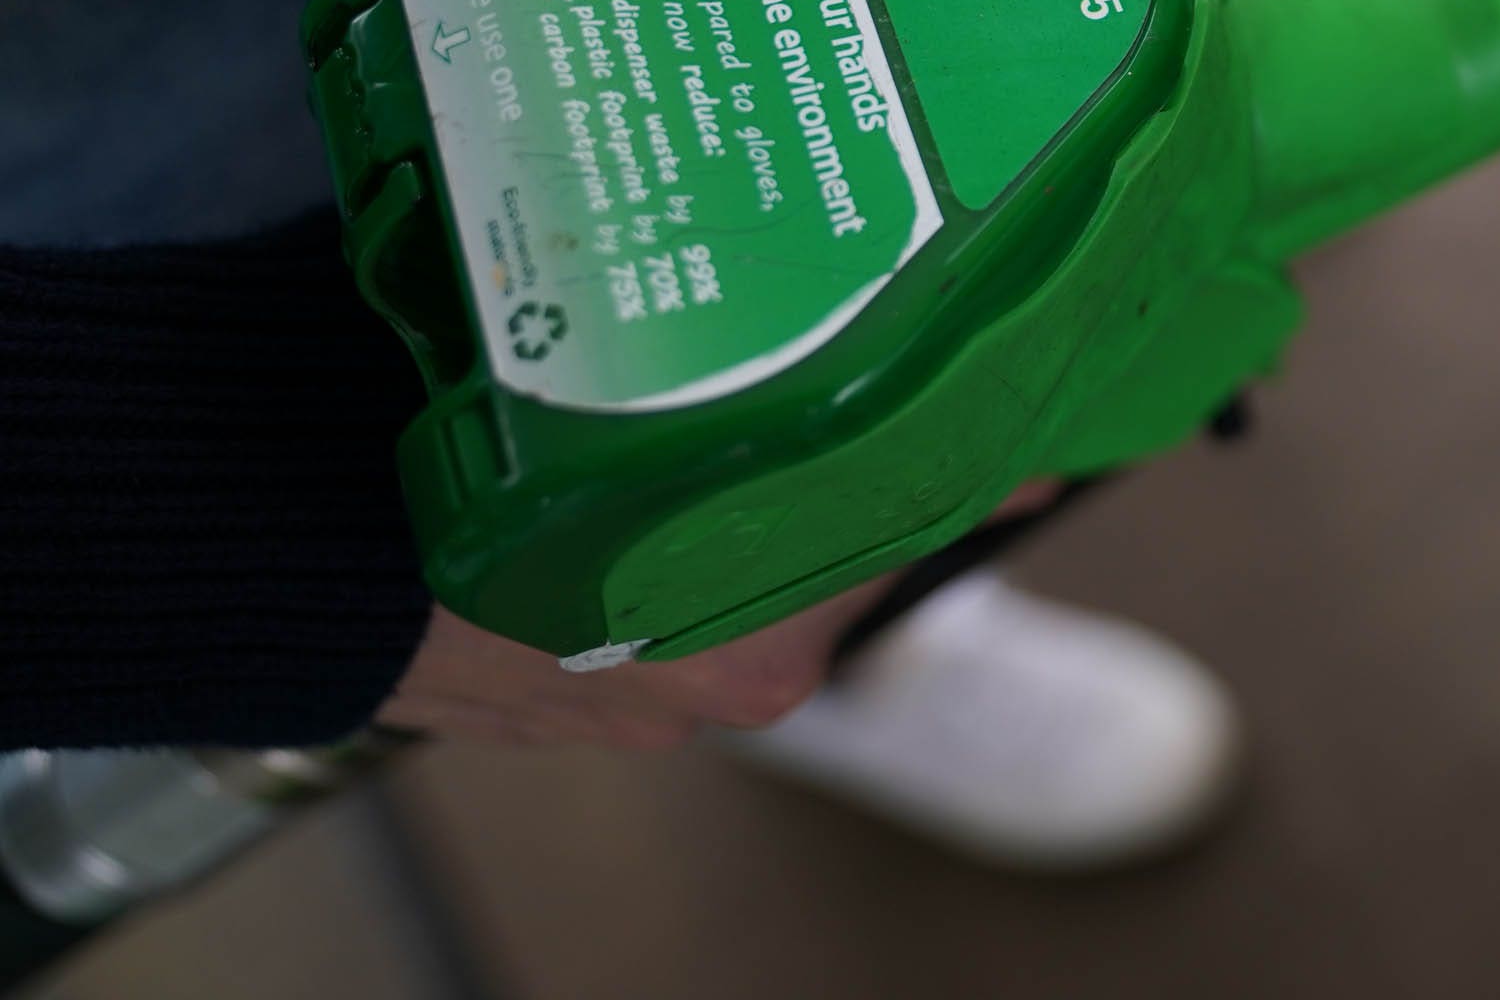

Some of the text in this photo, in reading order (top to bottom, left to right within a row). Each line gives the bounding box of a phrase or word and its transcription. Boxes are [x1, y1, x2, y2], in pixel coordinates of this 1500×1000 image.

[475, 14, 507, 62] use
[490, 66, 523, 123] one
[662, 1, 695, 52] now
[679, 64, 726, 157] reduce:
[729, 82, 755, 113] to
[831, 34, 890, 132] hands
[538, 12, 647, 322] carbon footprint by 75%
[568, 5, 685, 313] plastic footprint by 70%
[734, 125, 784, 212] gloves,
[773, 28, 867, 237] environment
[643, 113, 681, 185] waste
[664, 194, 694, 225] by
[679, 244, 723, 305] 99%
